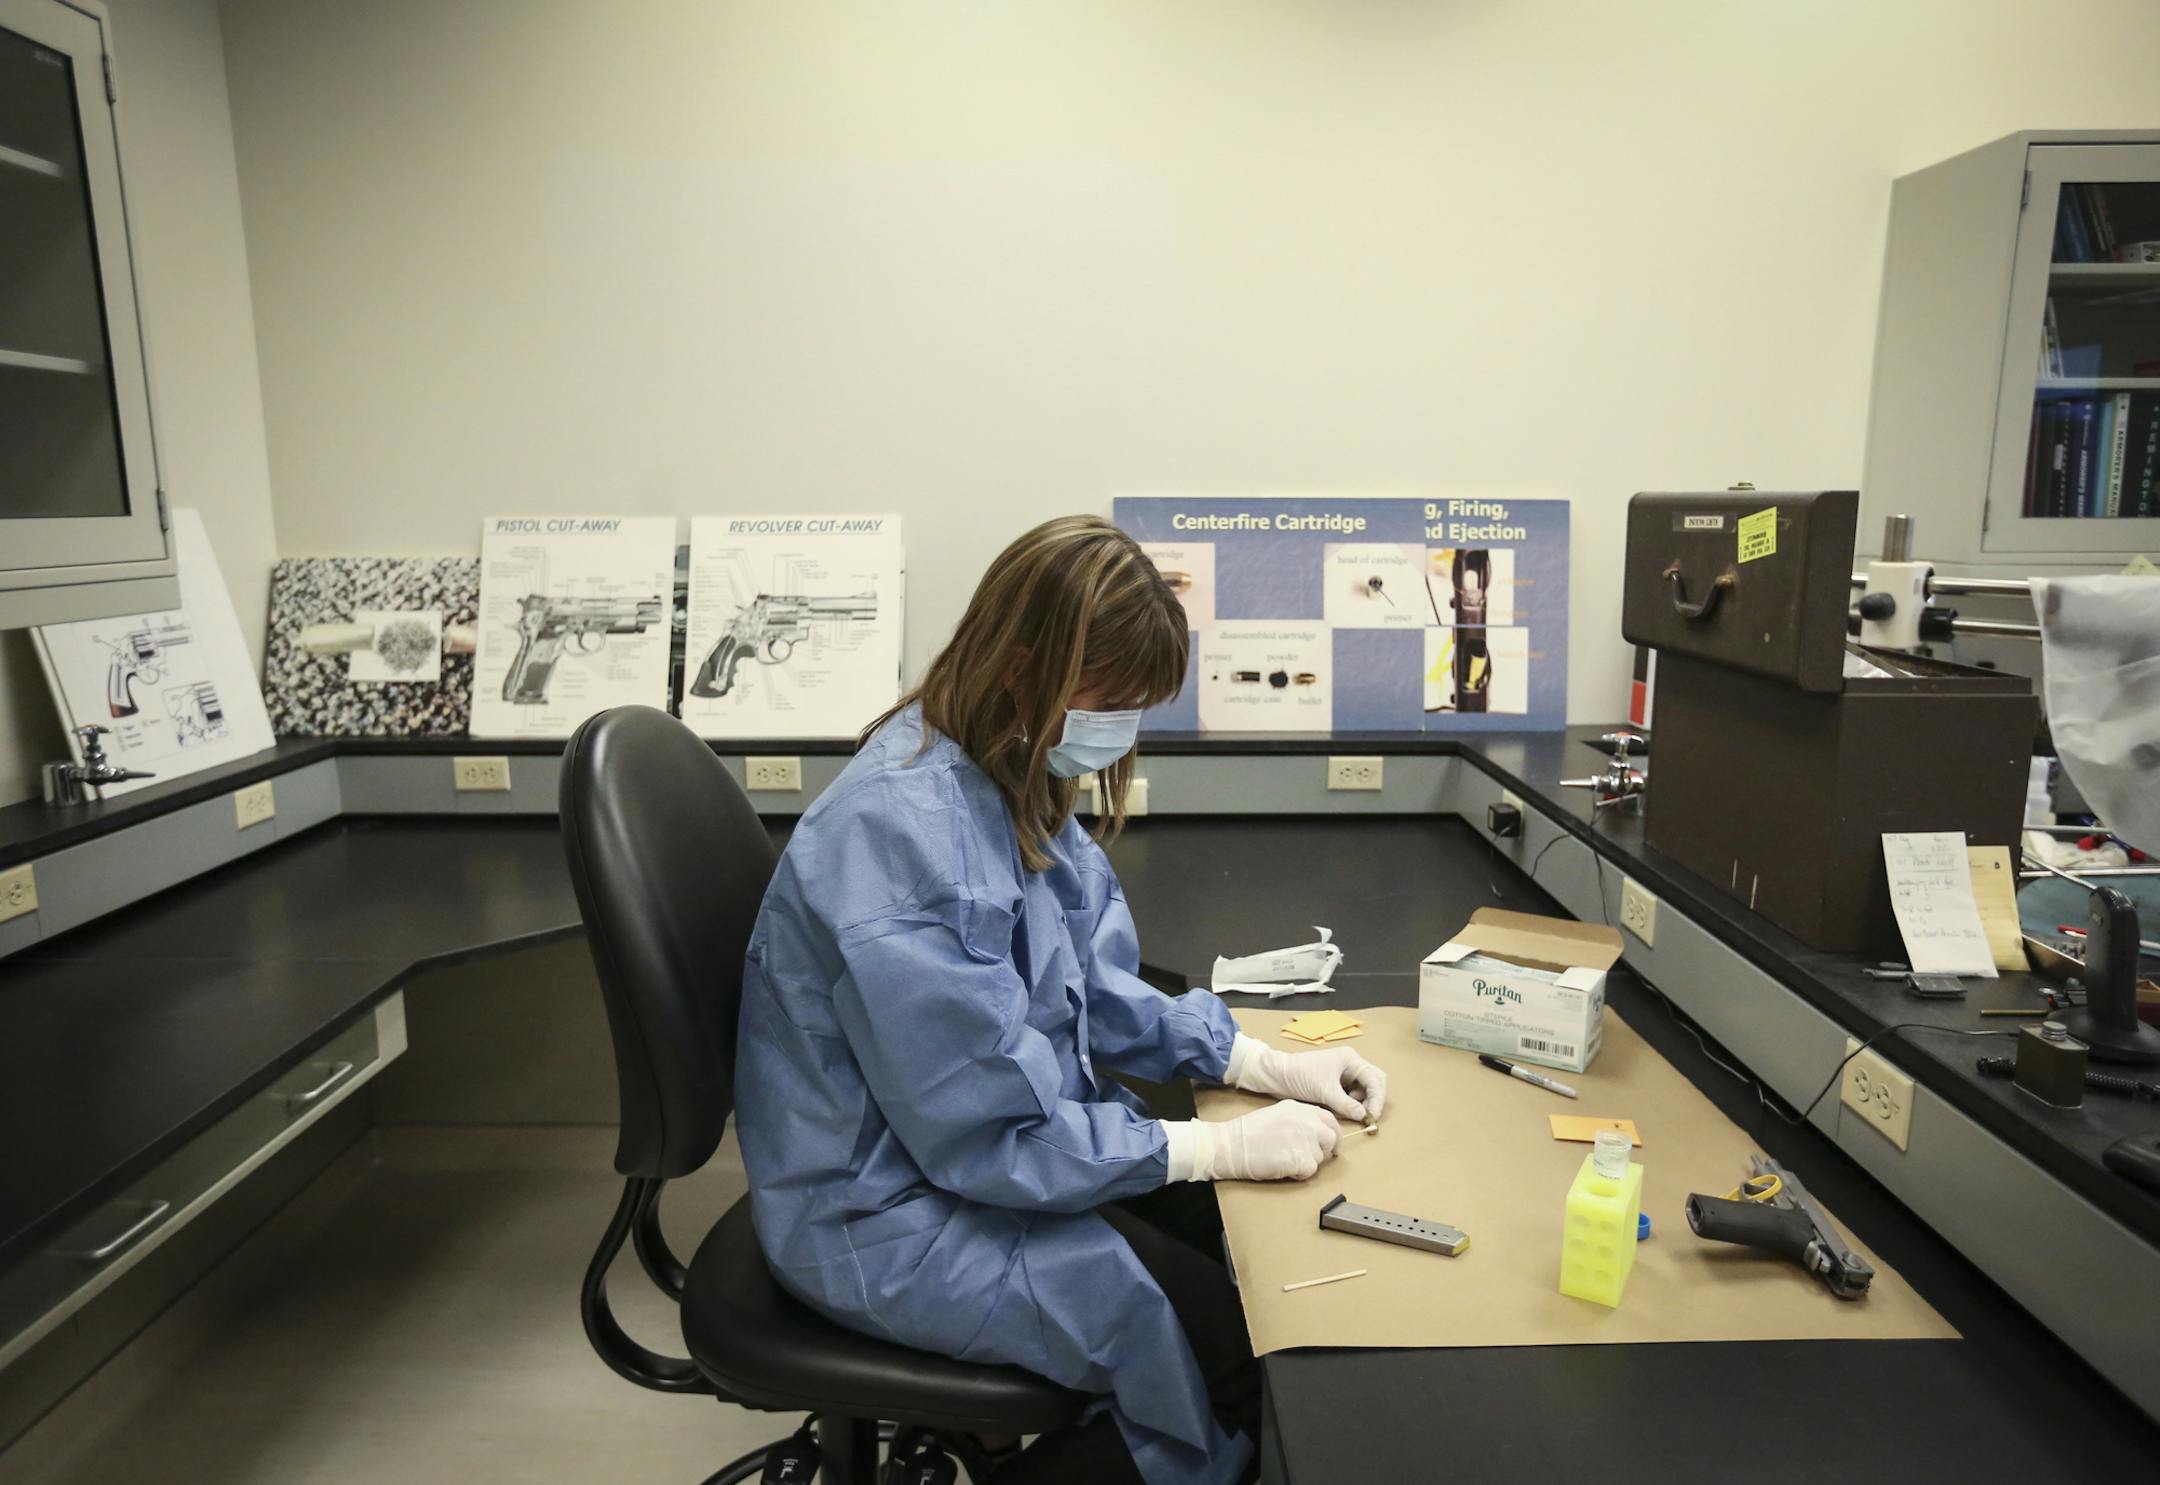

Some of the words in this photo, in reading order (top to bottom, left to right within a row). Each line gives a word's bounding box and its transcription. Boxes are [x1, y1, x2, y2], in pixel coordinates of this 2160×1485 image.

[1448, 500, 1509, 520] Firing,
[496, 519, 541, 532] PISTOL
[546, 519, 622, 532] CUT-AWAY
[729, 519, 803, 533] REVOLVER
[807, 519, 883, 532] CUT-AWAY
[1172, 513, 1270, 530] Centerfire
[1275, 513, 1366, 534] Cartridge
[1449, 523, 1526, 543] Ejection
[1337, 555, 1358, 564] head
[1371, 555, 1408, 566] cartridge
[1278, 631, 1316, 642] cartridge
[1472, 978, 1522, 1004] Puritan
